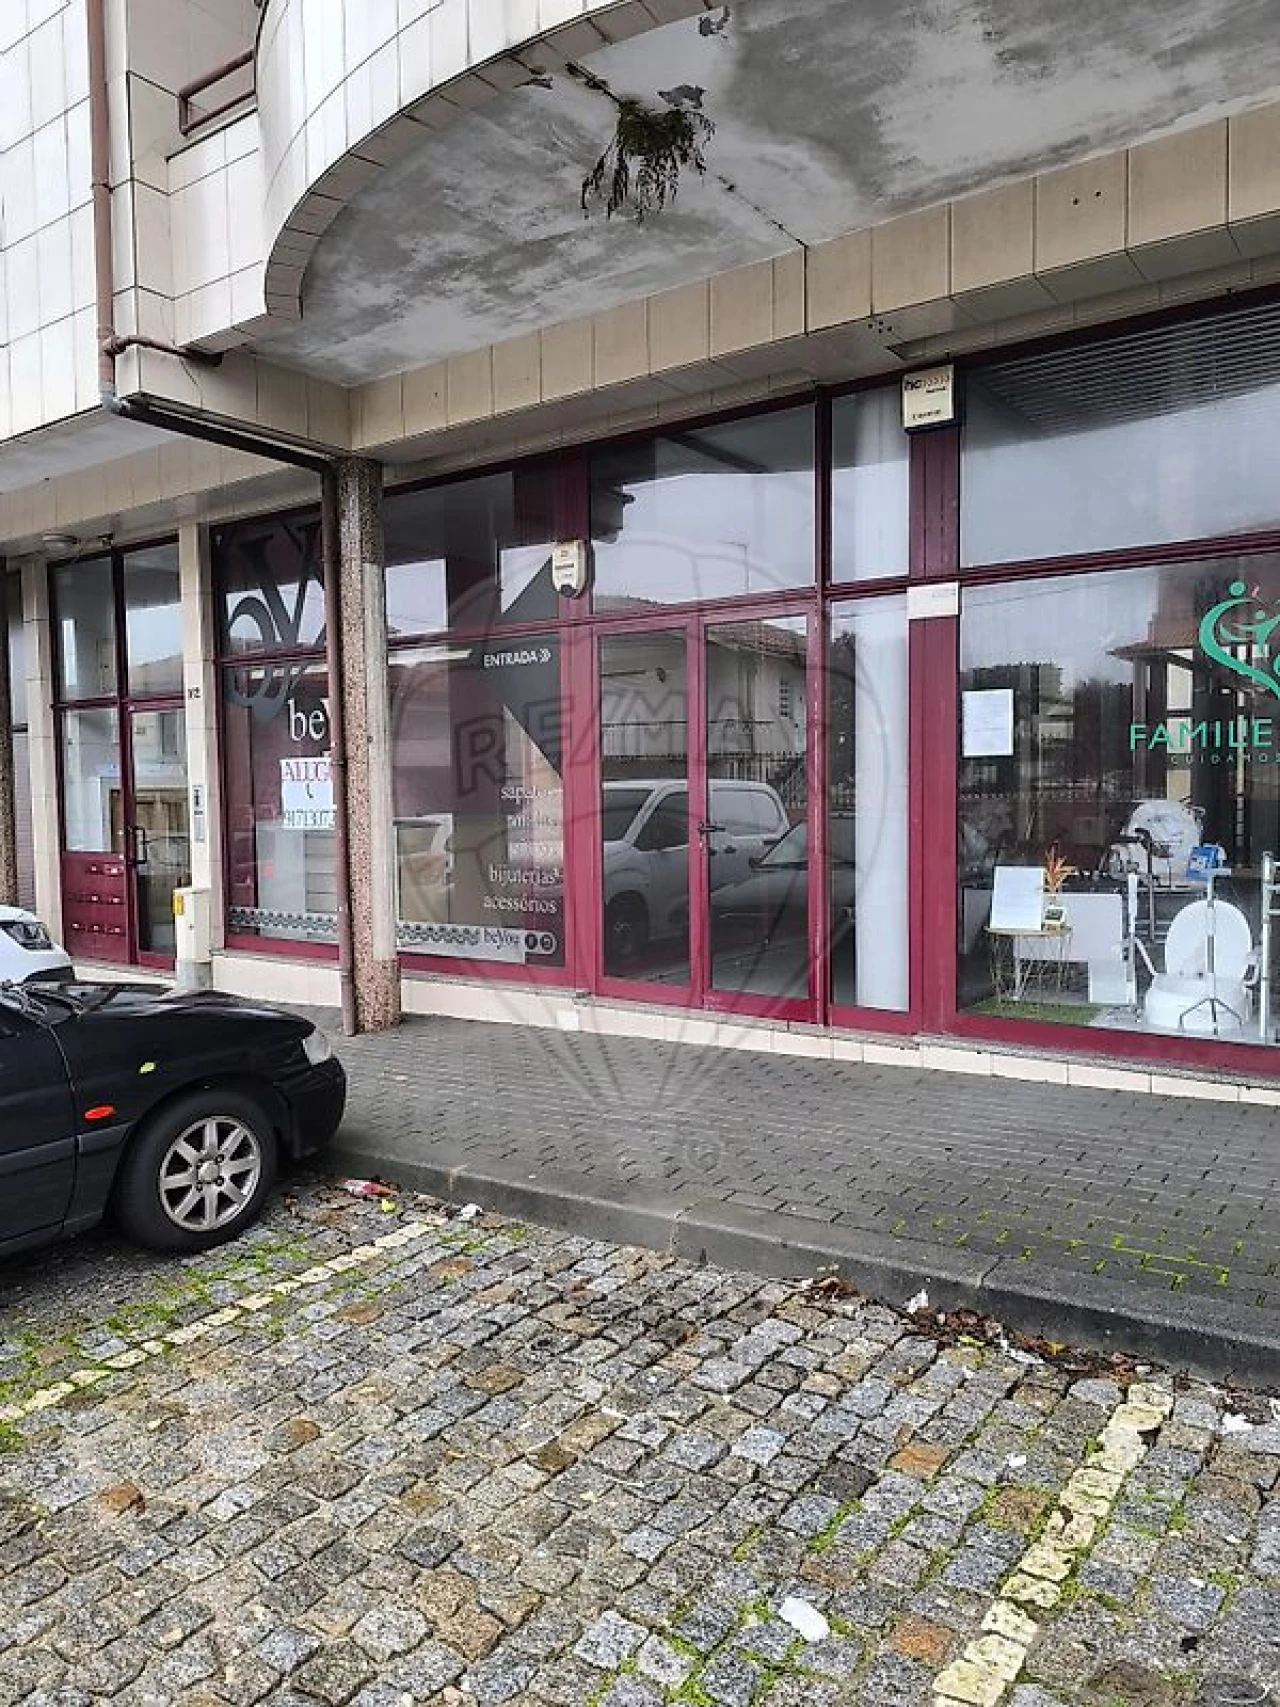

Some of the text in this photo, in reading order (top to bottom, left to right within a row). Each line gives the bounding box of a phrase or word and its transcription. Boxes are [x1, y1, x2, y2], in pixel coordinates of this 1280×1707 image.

[484, 650, 538, 667] ENTRADA
[1130, 719, 1272, 750] FAMILE
[484, 894, 557, 914] acessórios
